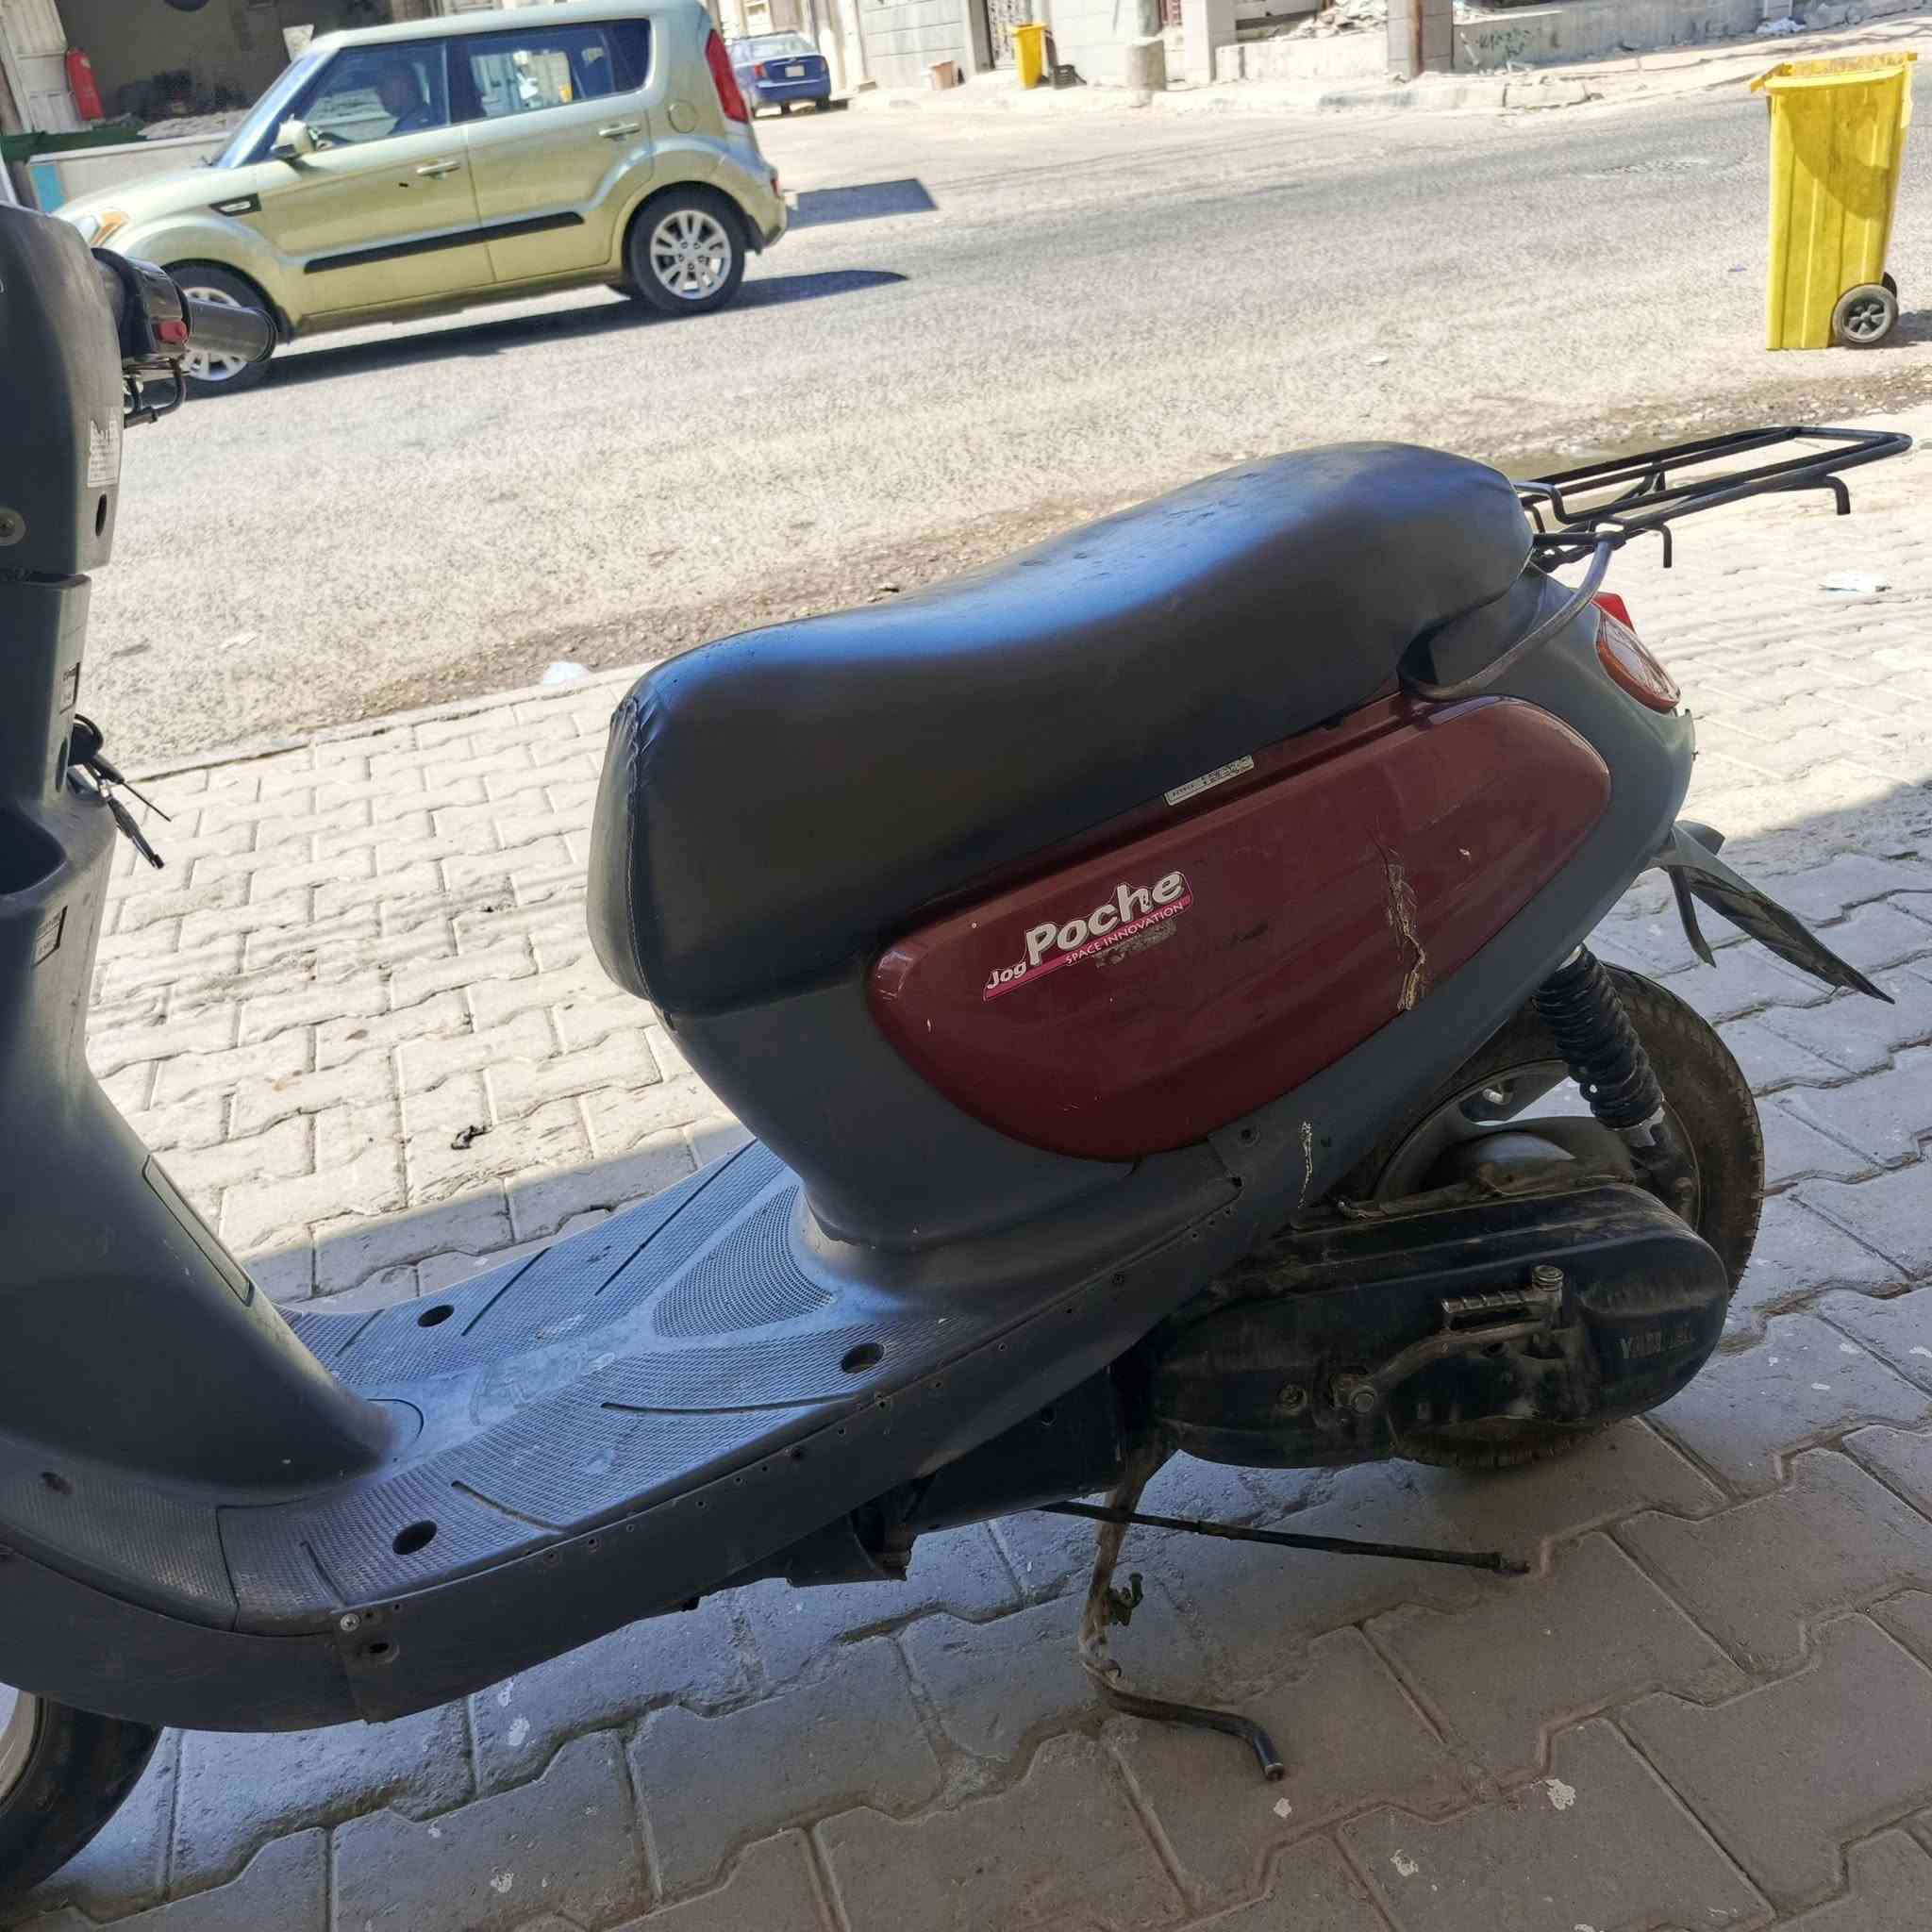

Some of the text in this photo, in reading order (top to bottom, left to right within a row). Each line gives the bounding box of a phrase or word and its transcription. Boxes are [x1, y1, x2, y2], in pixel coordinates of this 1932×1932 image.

[987, 873, 1186, 990] Jog Poche
[1065, 901, 1185, 965] SPACE INNOVATION
